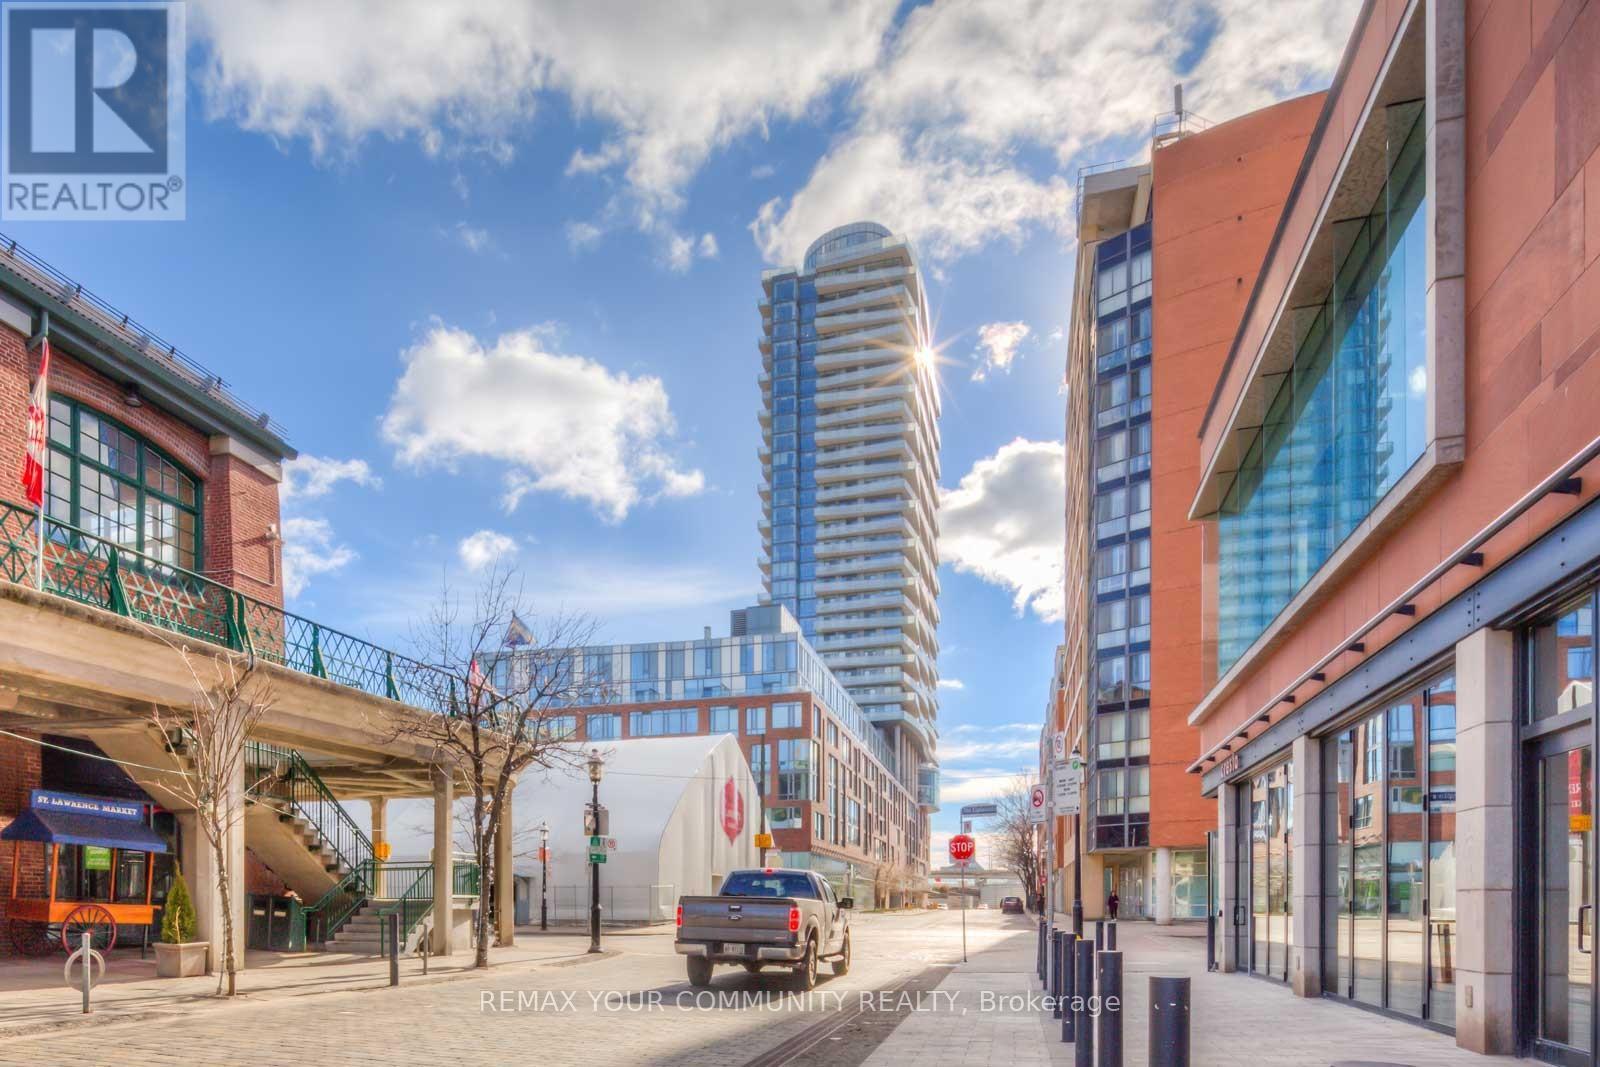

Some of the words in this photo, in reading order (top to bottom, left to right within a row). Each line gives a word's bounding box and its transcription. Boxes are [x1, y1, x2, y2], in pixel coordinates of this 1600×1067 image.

[37, 796, 49, 804] ST.
[51, 798, 99, 811] LAWRENCE
[102, 805, 137, 815] MARKET
[950, 841, 974, 853] STOP
